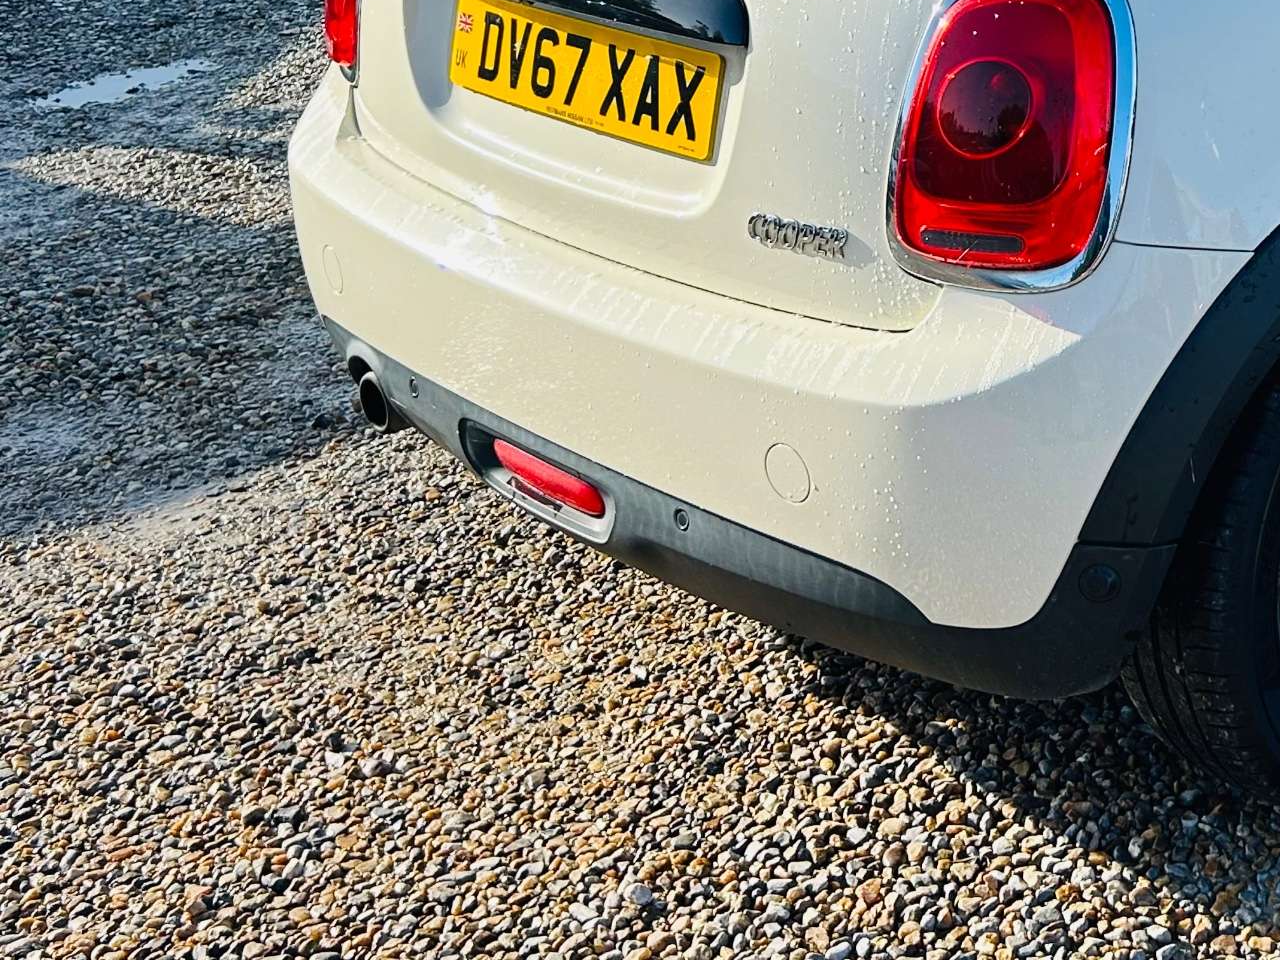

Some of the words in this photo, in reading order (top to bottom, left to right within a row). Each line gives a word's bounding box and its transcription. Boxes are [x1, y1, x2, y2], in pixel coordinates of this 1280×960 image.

[455, 48, 469, 69] UK
[477, 10, 593, 106] DV67
[599, 43, 706, 142] XAX
[748, 213, 849, 259] COOPER
